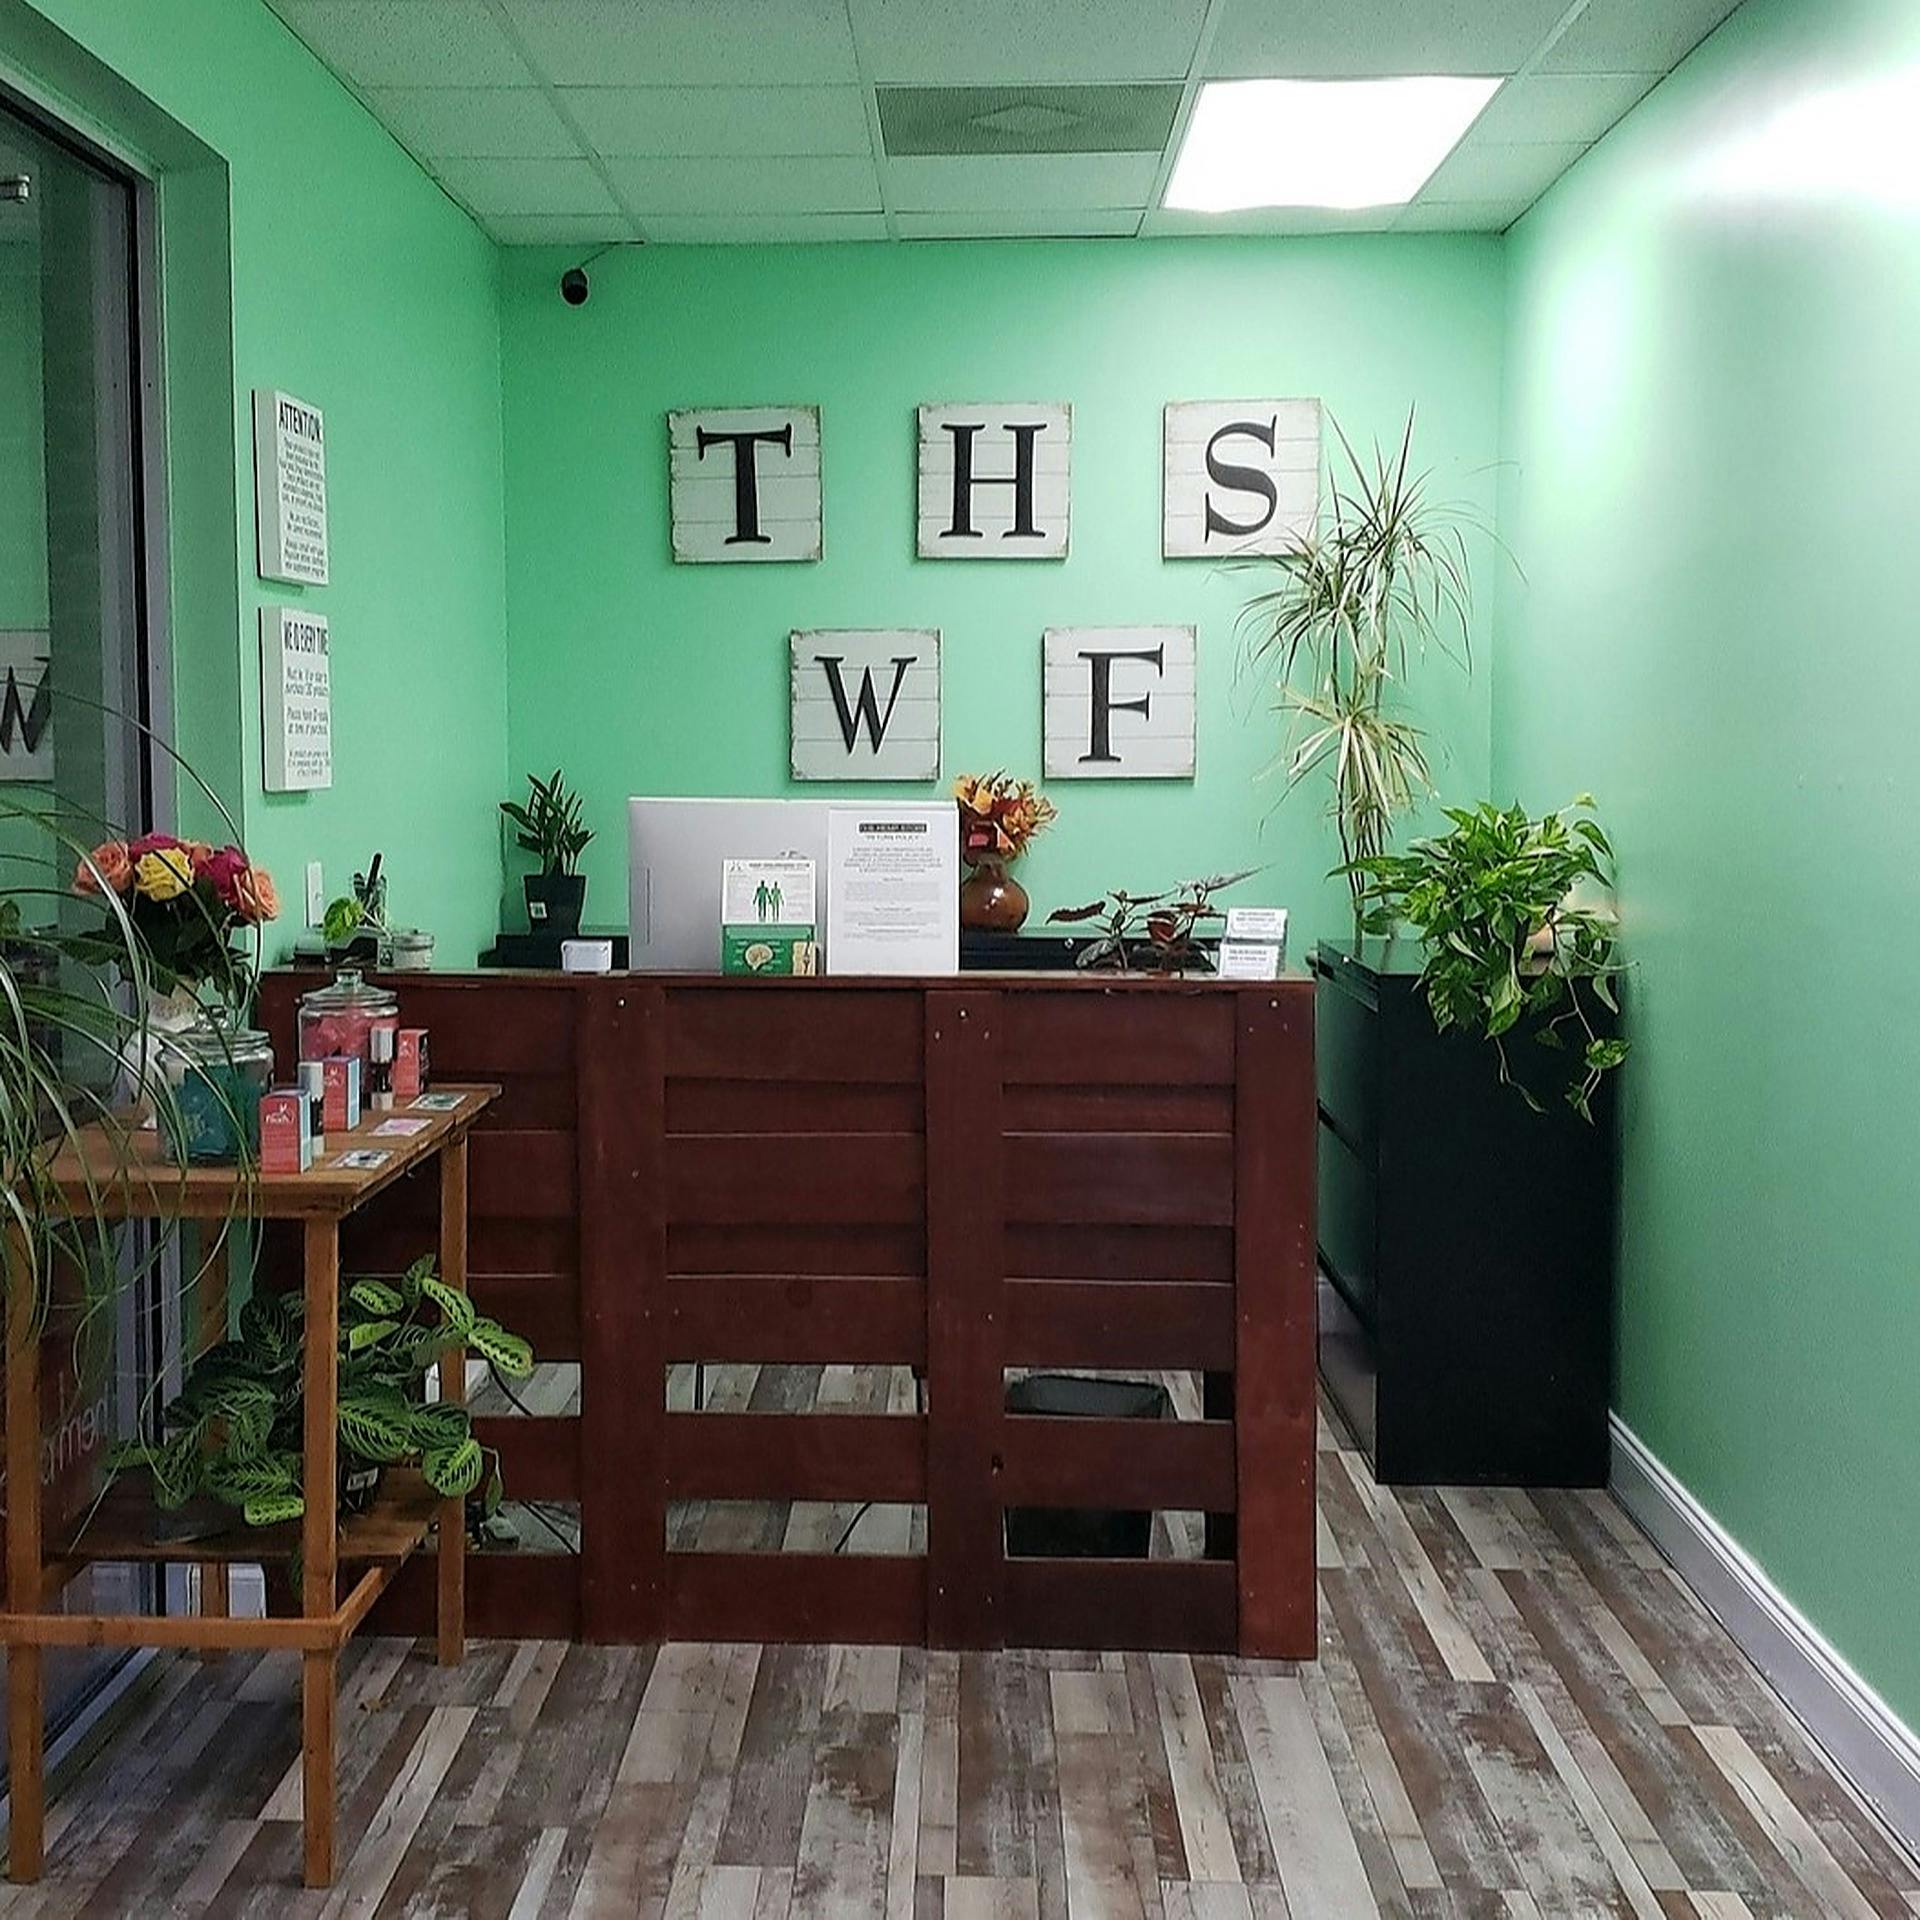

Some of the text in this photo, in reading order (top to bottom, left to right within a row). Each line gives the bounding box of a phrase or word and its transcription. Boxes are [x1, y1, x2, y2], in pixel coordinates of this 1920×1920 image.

[696, 414, 1279, 544] T H S
[814, 642, 1164, 763] W F
